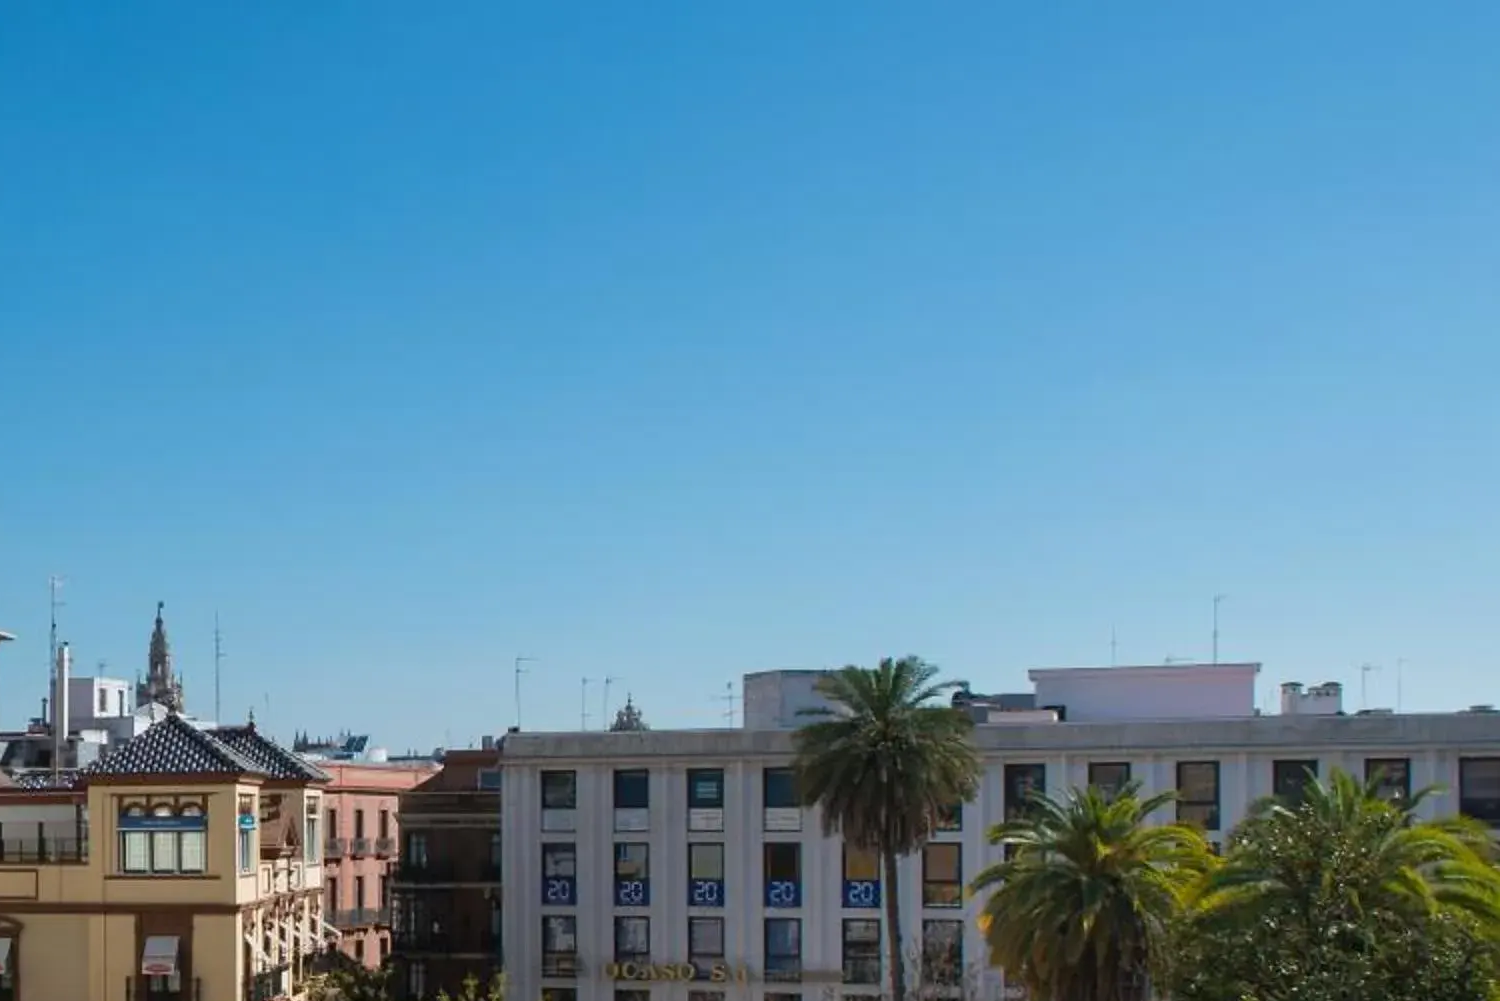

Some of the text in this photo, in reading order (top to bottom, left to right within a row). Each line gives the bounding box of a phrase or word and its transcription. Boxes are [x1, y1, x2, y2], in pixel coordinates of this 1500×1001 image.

[548, 880, 569, 900] 20
[620, 881, 643, 900] 20
[694, 881, 718, 900] 20
[769, 881, 795, 901] 20
[850, 882, 873, 901] 20
